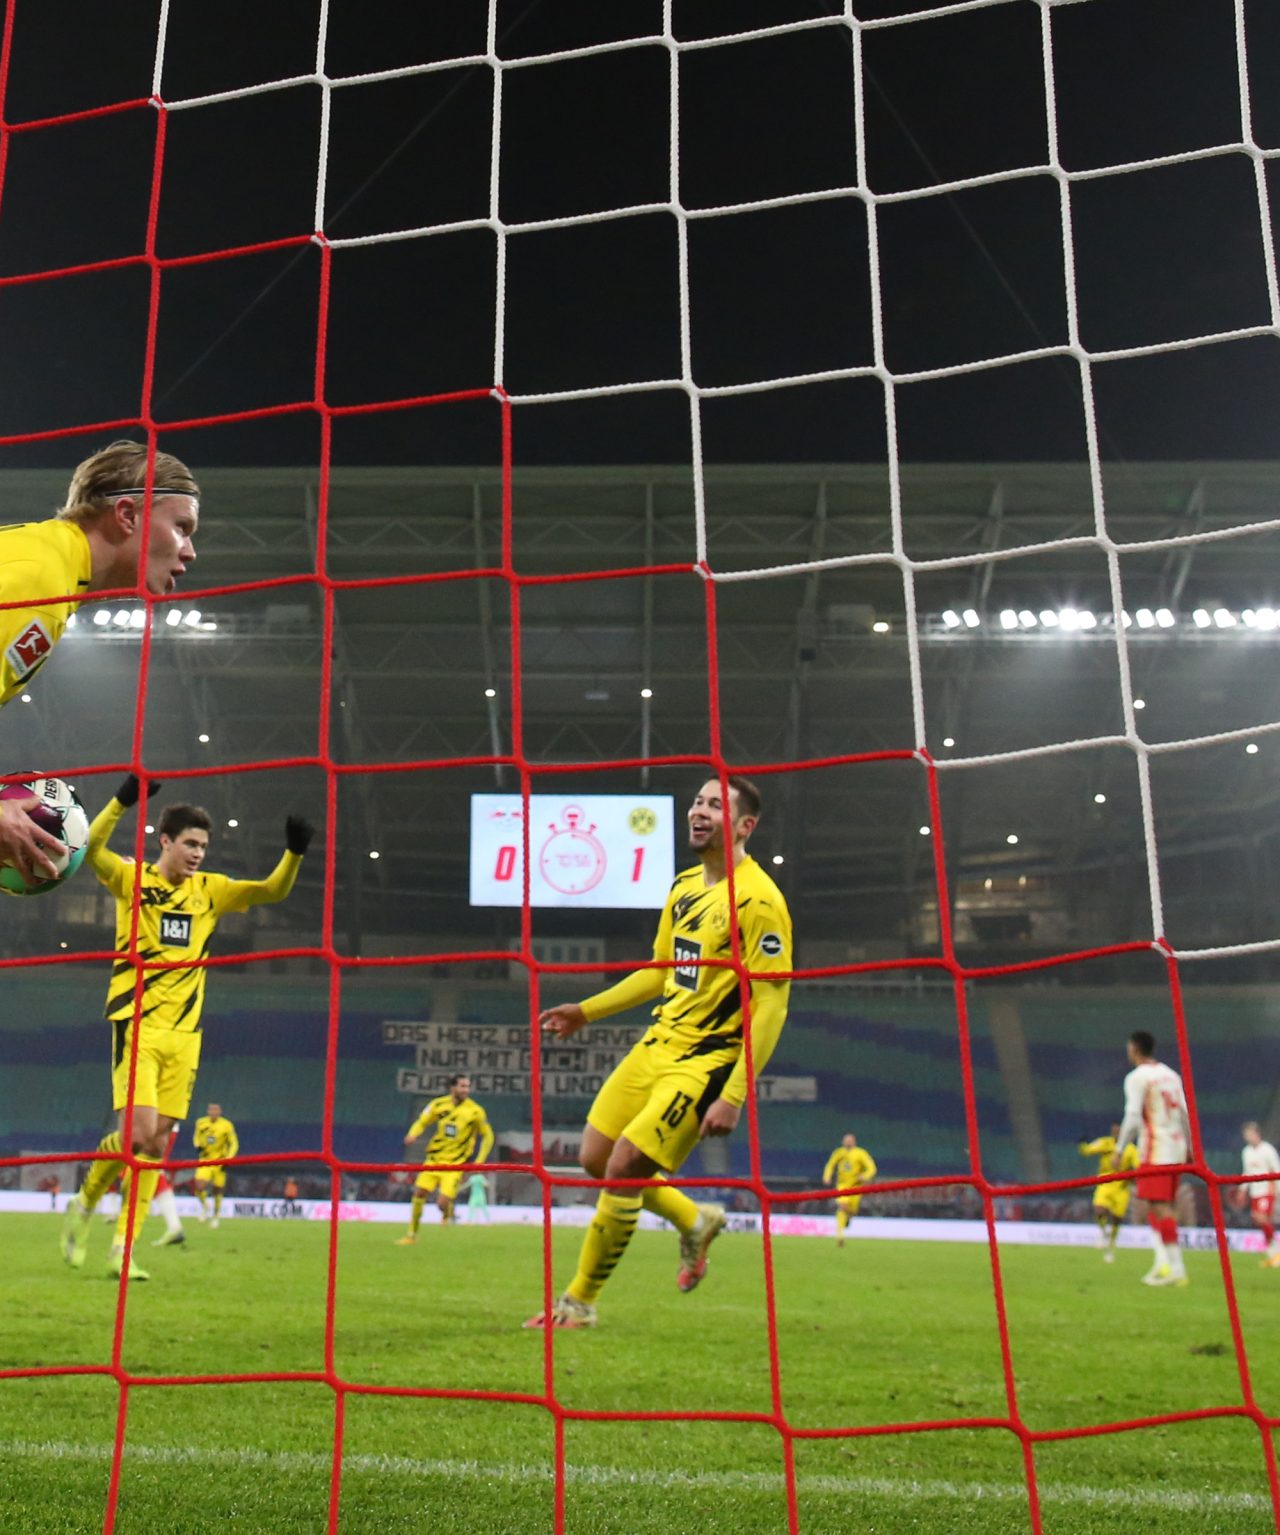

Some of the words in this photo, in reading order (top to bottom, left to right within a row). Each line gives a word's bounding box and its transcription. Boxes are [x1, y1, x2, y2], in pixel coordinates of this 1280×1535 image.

[494, 846, 517, 882] 0
[631, 847, 645, 883] 1
[162, 919, 189, 940] 1&1
[383, 1024, 429, 1042] DAS
[436, 1027, 498, 1044] HERZ
[420, 1049, 468, 1067] NUR
[476, 1050, 512, 1068] MIT
[660, 1090, 693, 1128] 13
